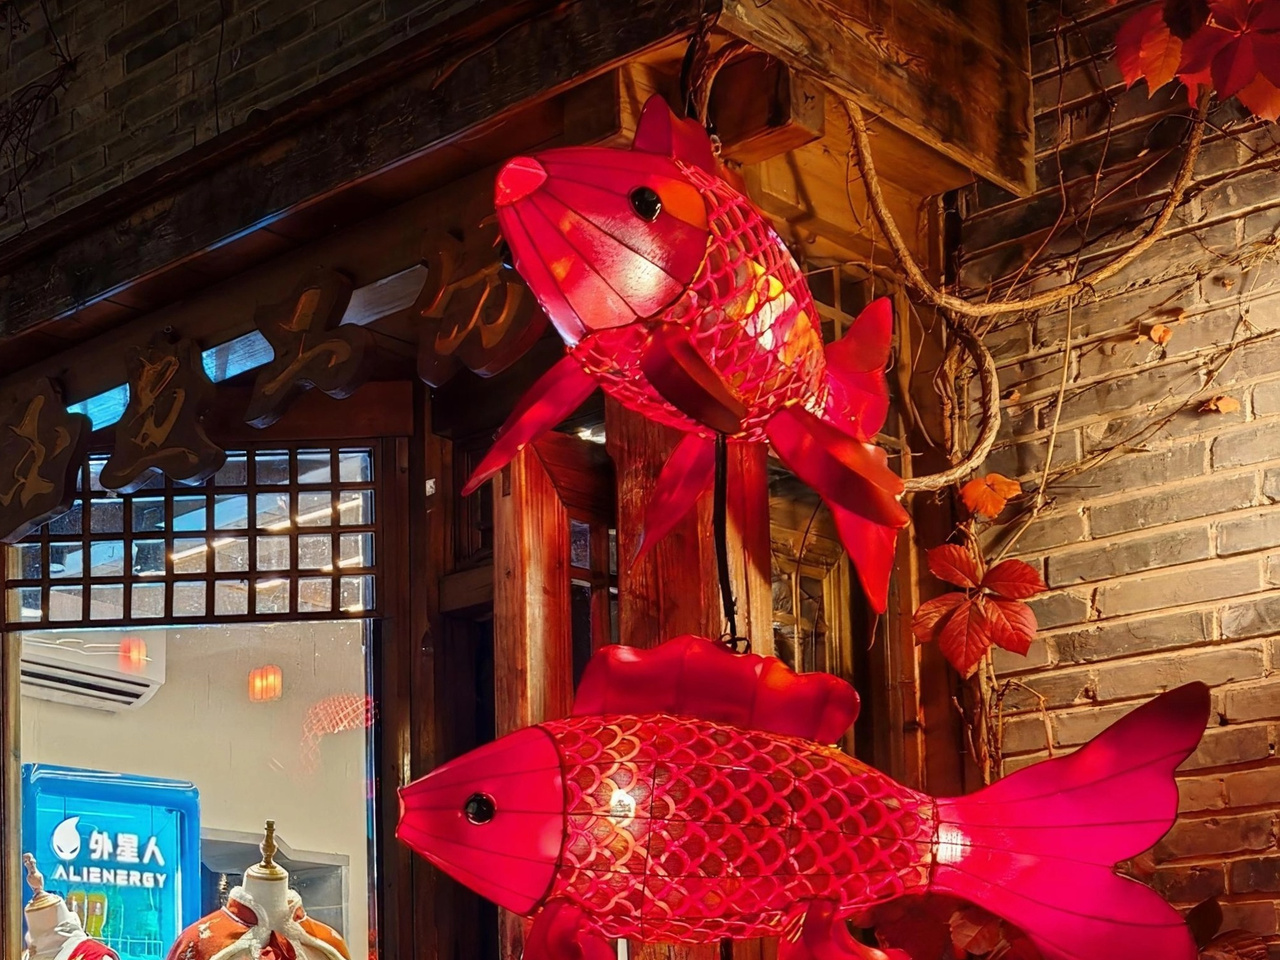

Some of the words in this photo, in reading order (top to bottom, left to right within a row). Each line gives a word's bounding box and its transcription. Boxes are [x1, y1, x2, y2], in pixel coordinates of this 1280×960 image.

[90, 831, 165, 866] 外星人
[53, 865, 167, 888] ALIENERGY
